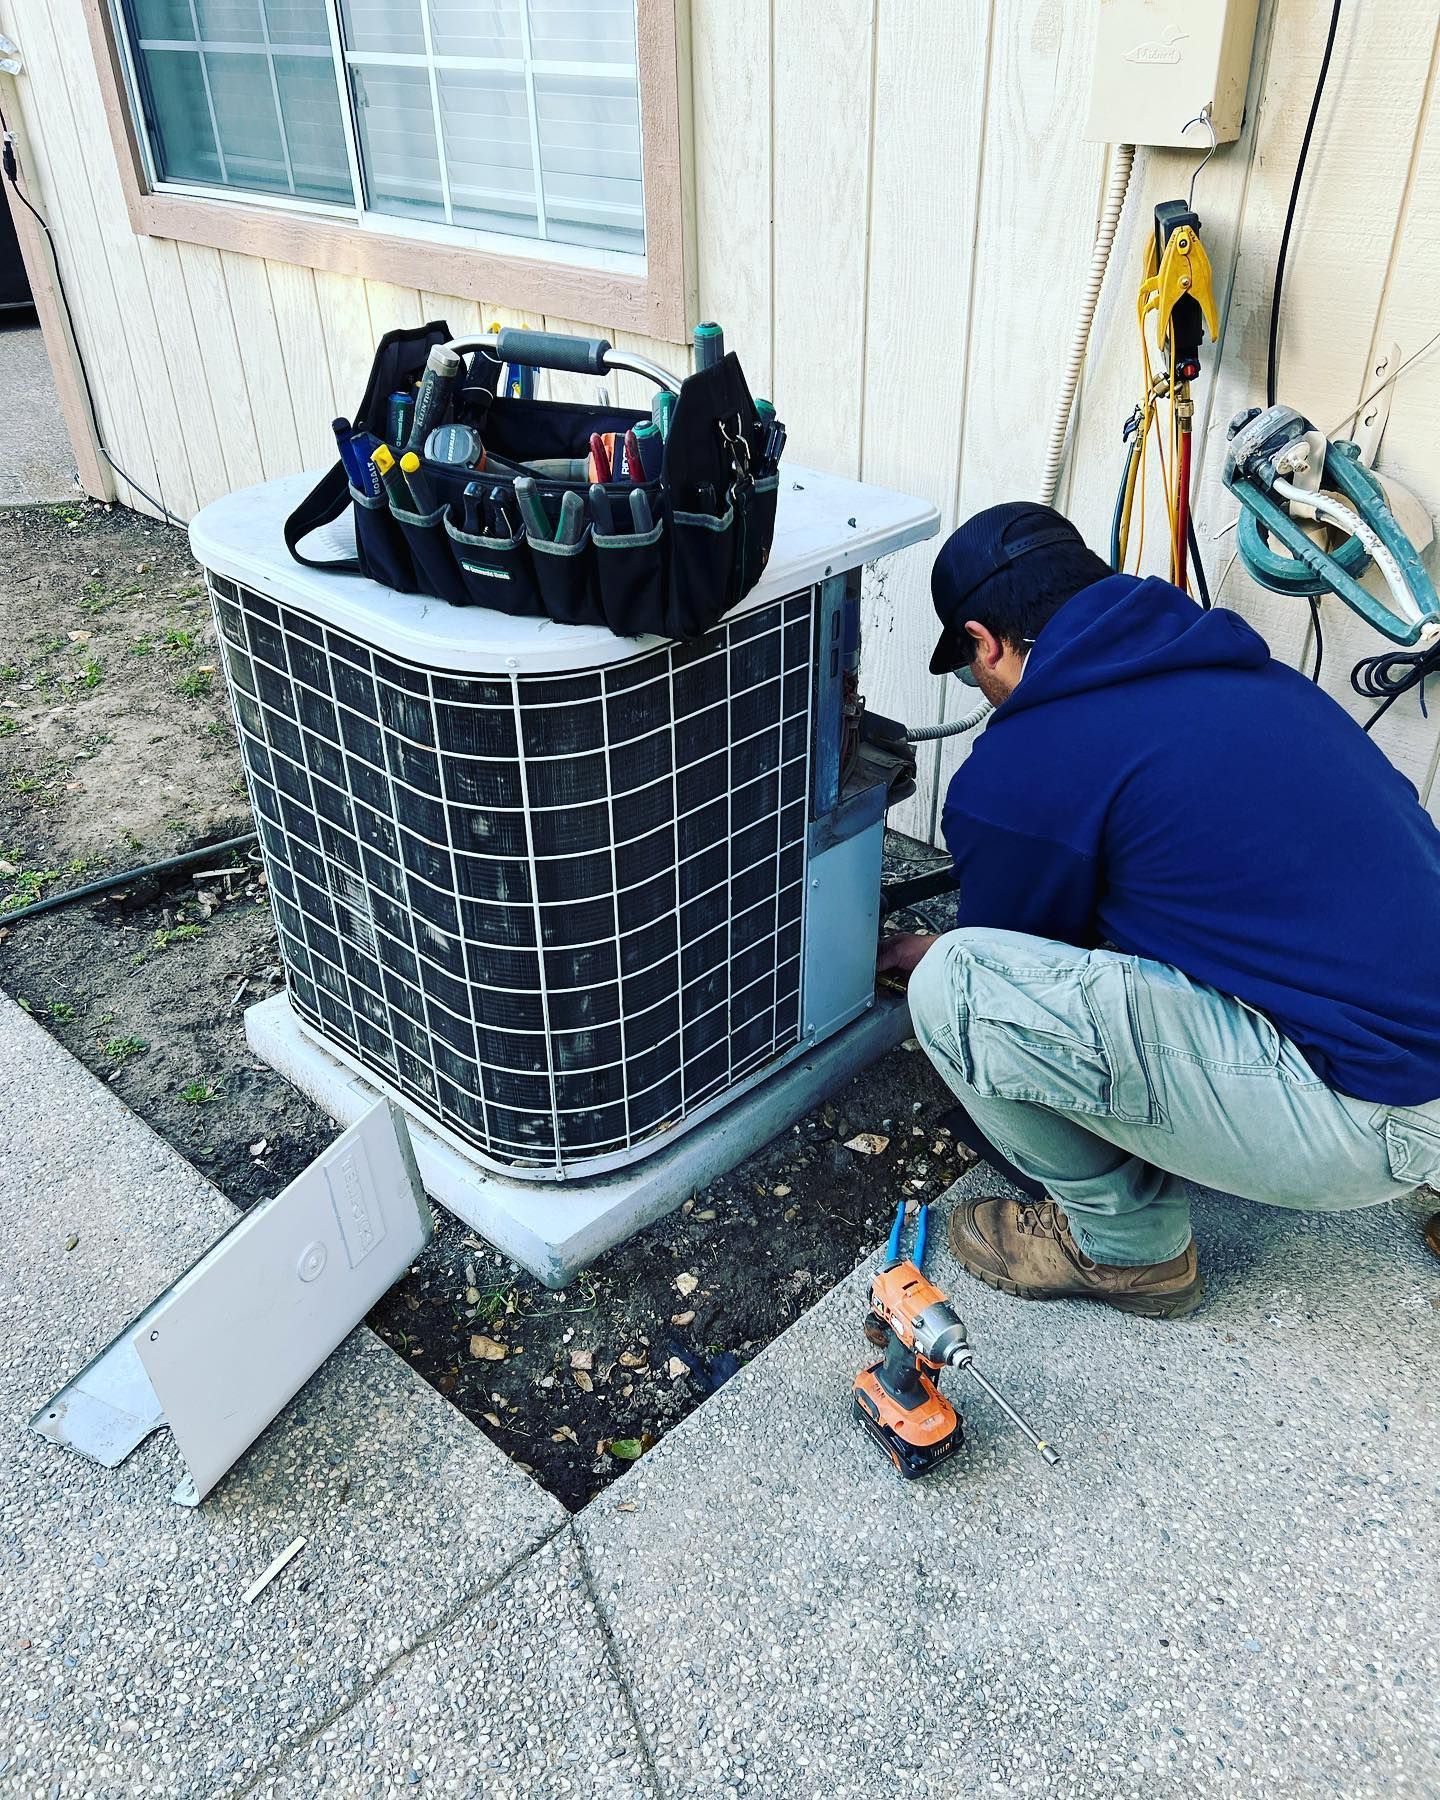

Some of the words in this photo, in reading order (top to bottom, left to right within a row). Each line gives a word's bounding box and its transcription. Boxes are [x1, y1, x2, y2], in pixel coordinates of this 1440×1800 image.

[417, 402, 427, 427] KLEIN
[424, 380, 434, 403] TOOLS
[367, 462, 380, 495] KOBALT
